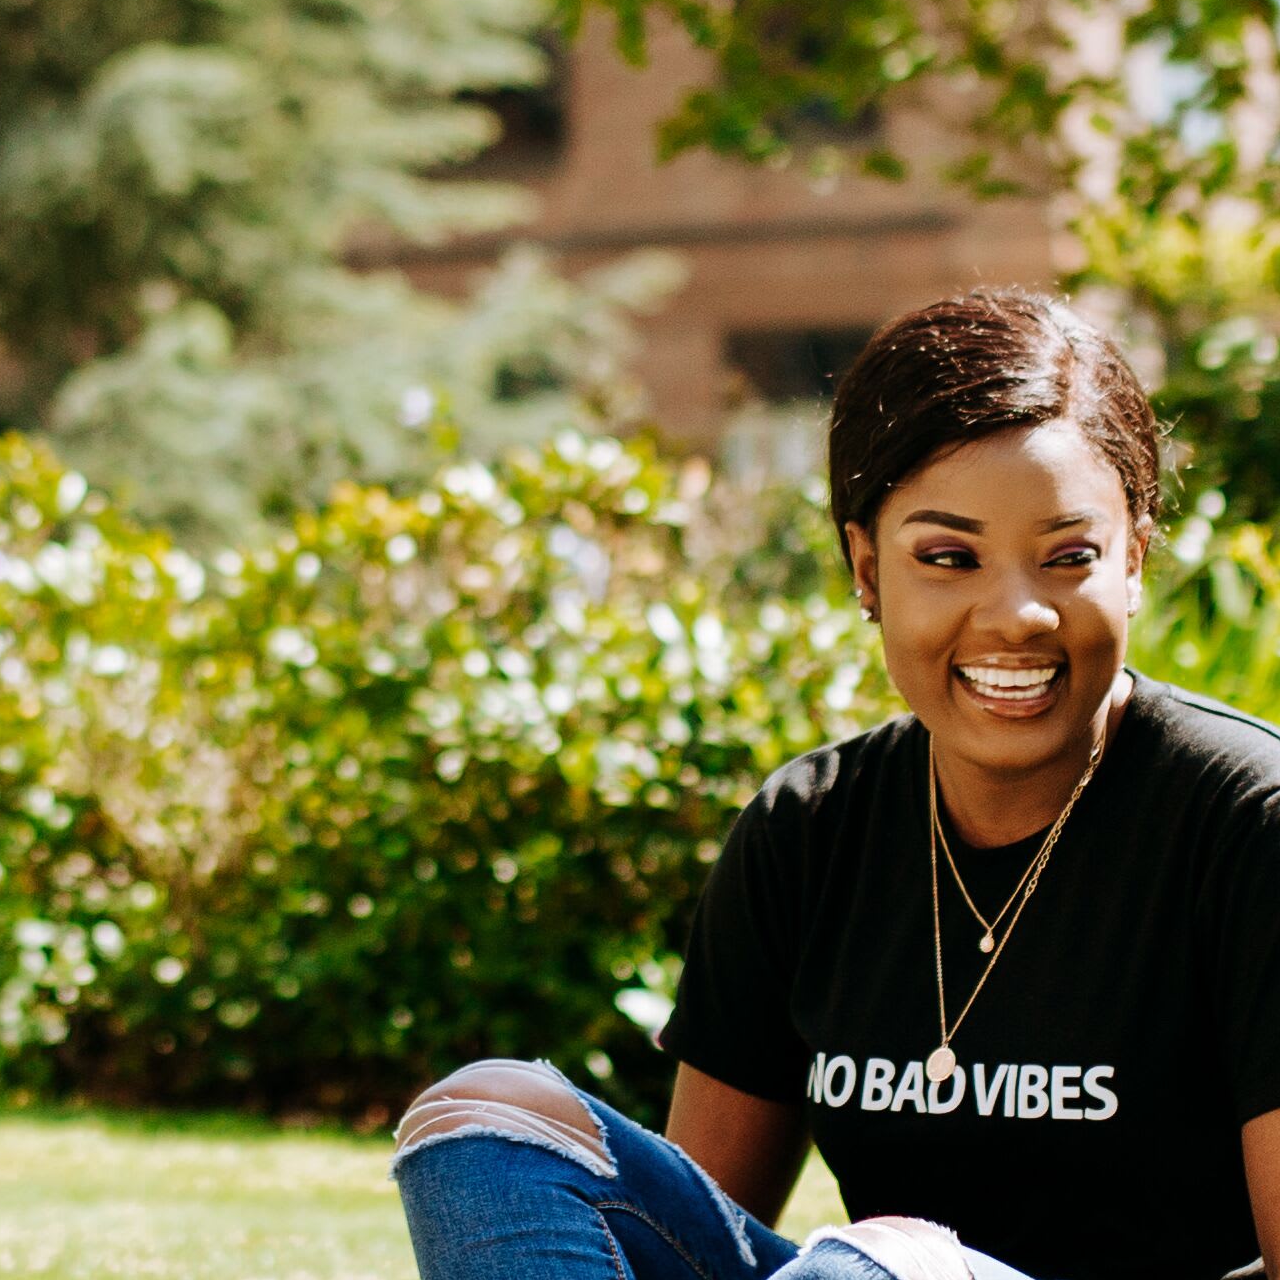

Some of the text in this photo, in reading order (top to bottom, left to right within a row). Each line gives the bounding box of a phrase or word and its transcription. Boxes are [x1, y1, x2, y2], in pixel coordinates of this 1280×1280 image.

[807, 1052, 1118, 1121] NO BAD VIBES
